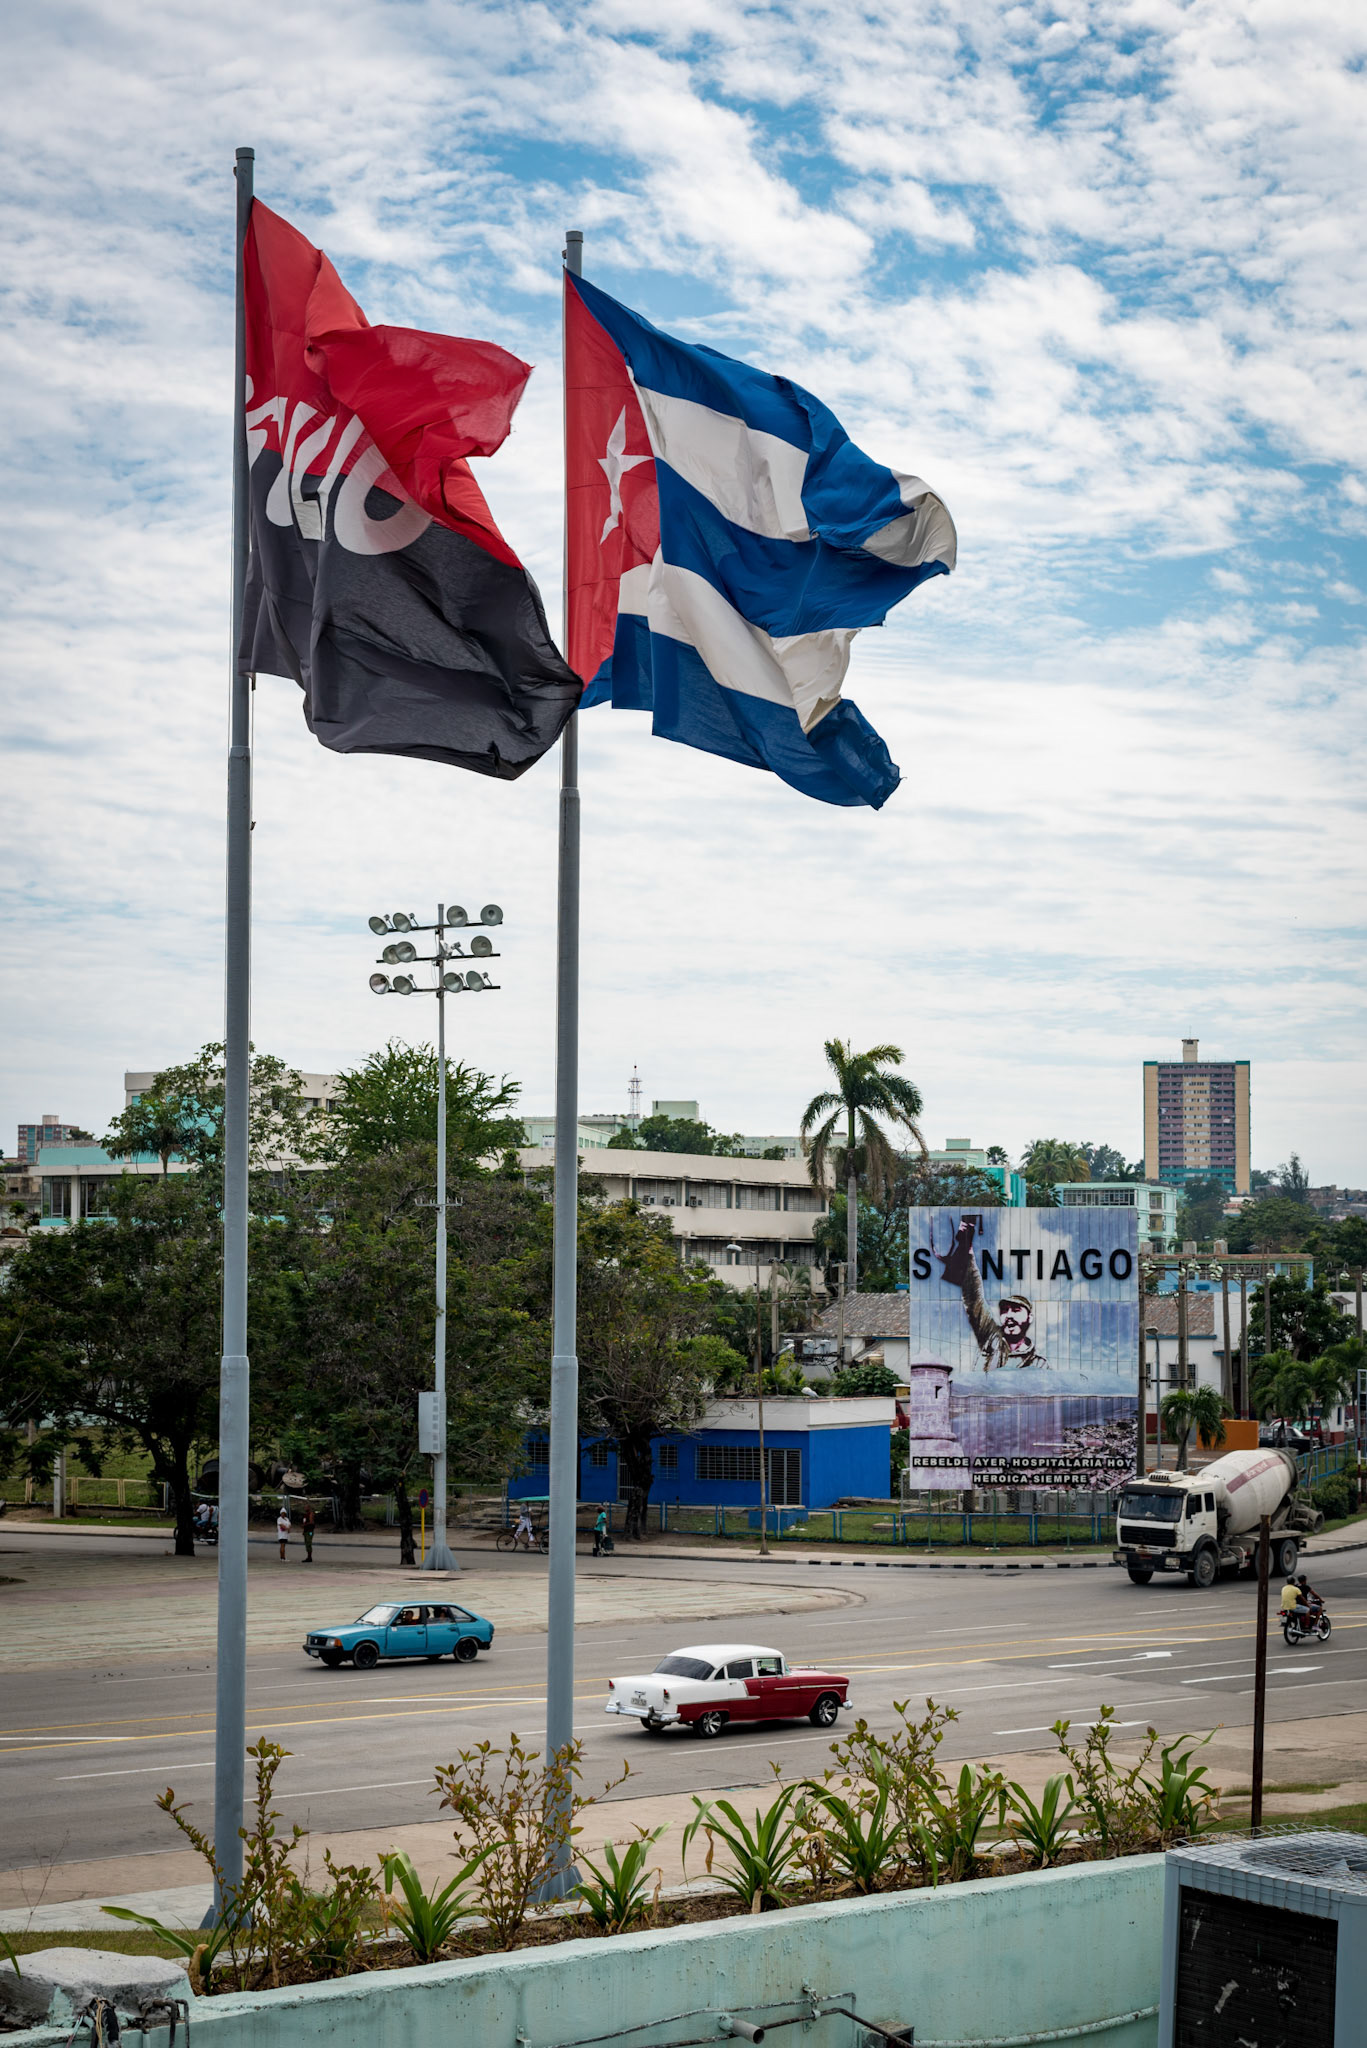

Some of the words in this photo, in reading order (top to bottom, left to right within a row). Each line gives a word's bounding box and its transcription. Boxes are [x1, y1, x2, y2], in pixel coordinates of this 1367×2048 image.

[912, 1457, 970, 1467] REBELDE
[1011, 1458, 1103, 1468] HOSPITALARIA
[1106, 1458, 1133, 1468] HOY
[972, 1474, 1028, 1483] HEROICA
[1032, 1474, 1088, 1483] SIEMPRE
